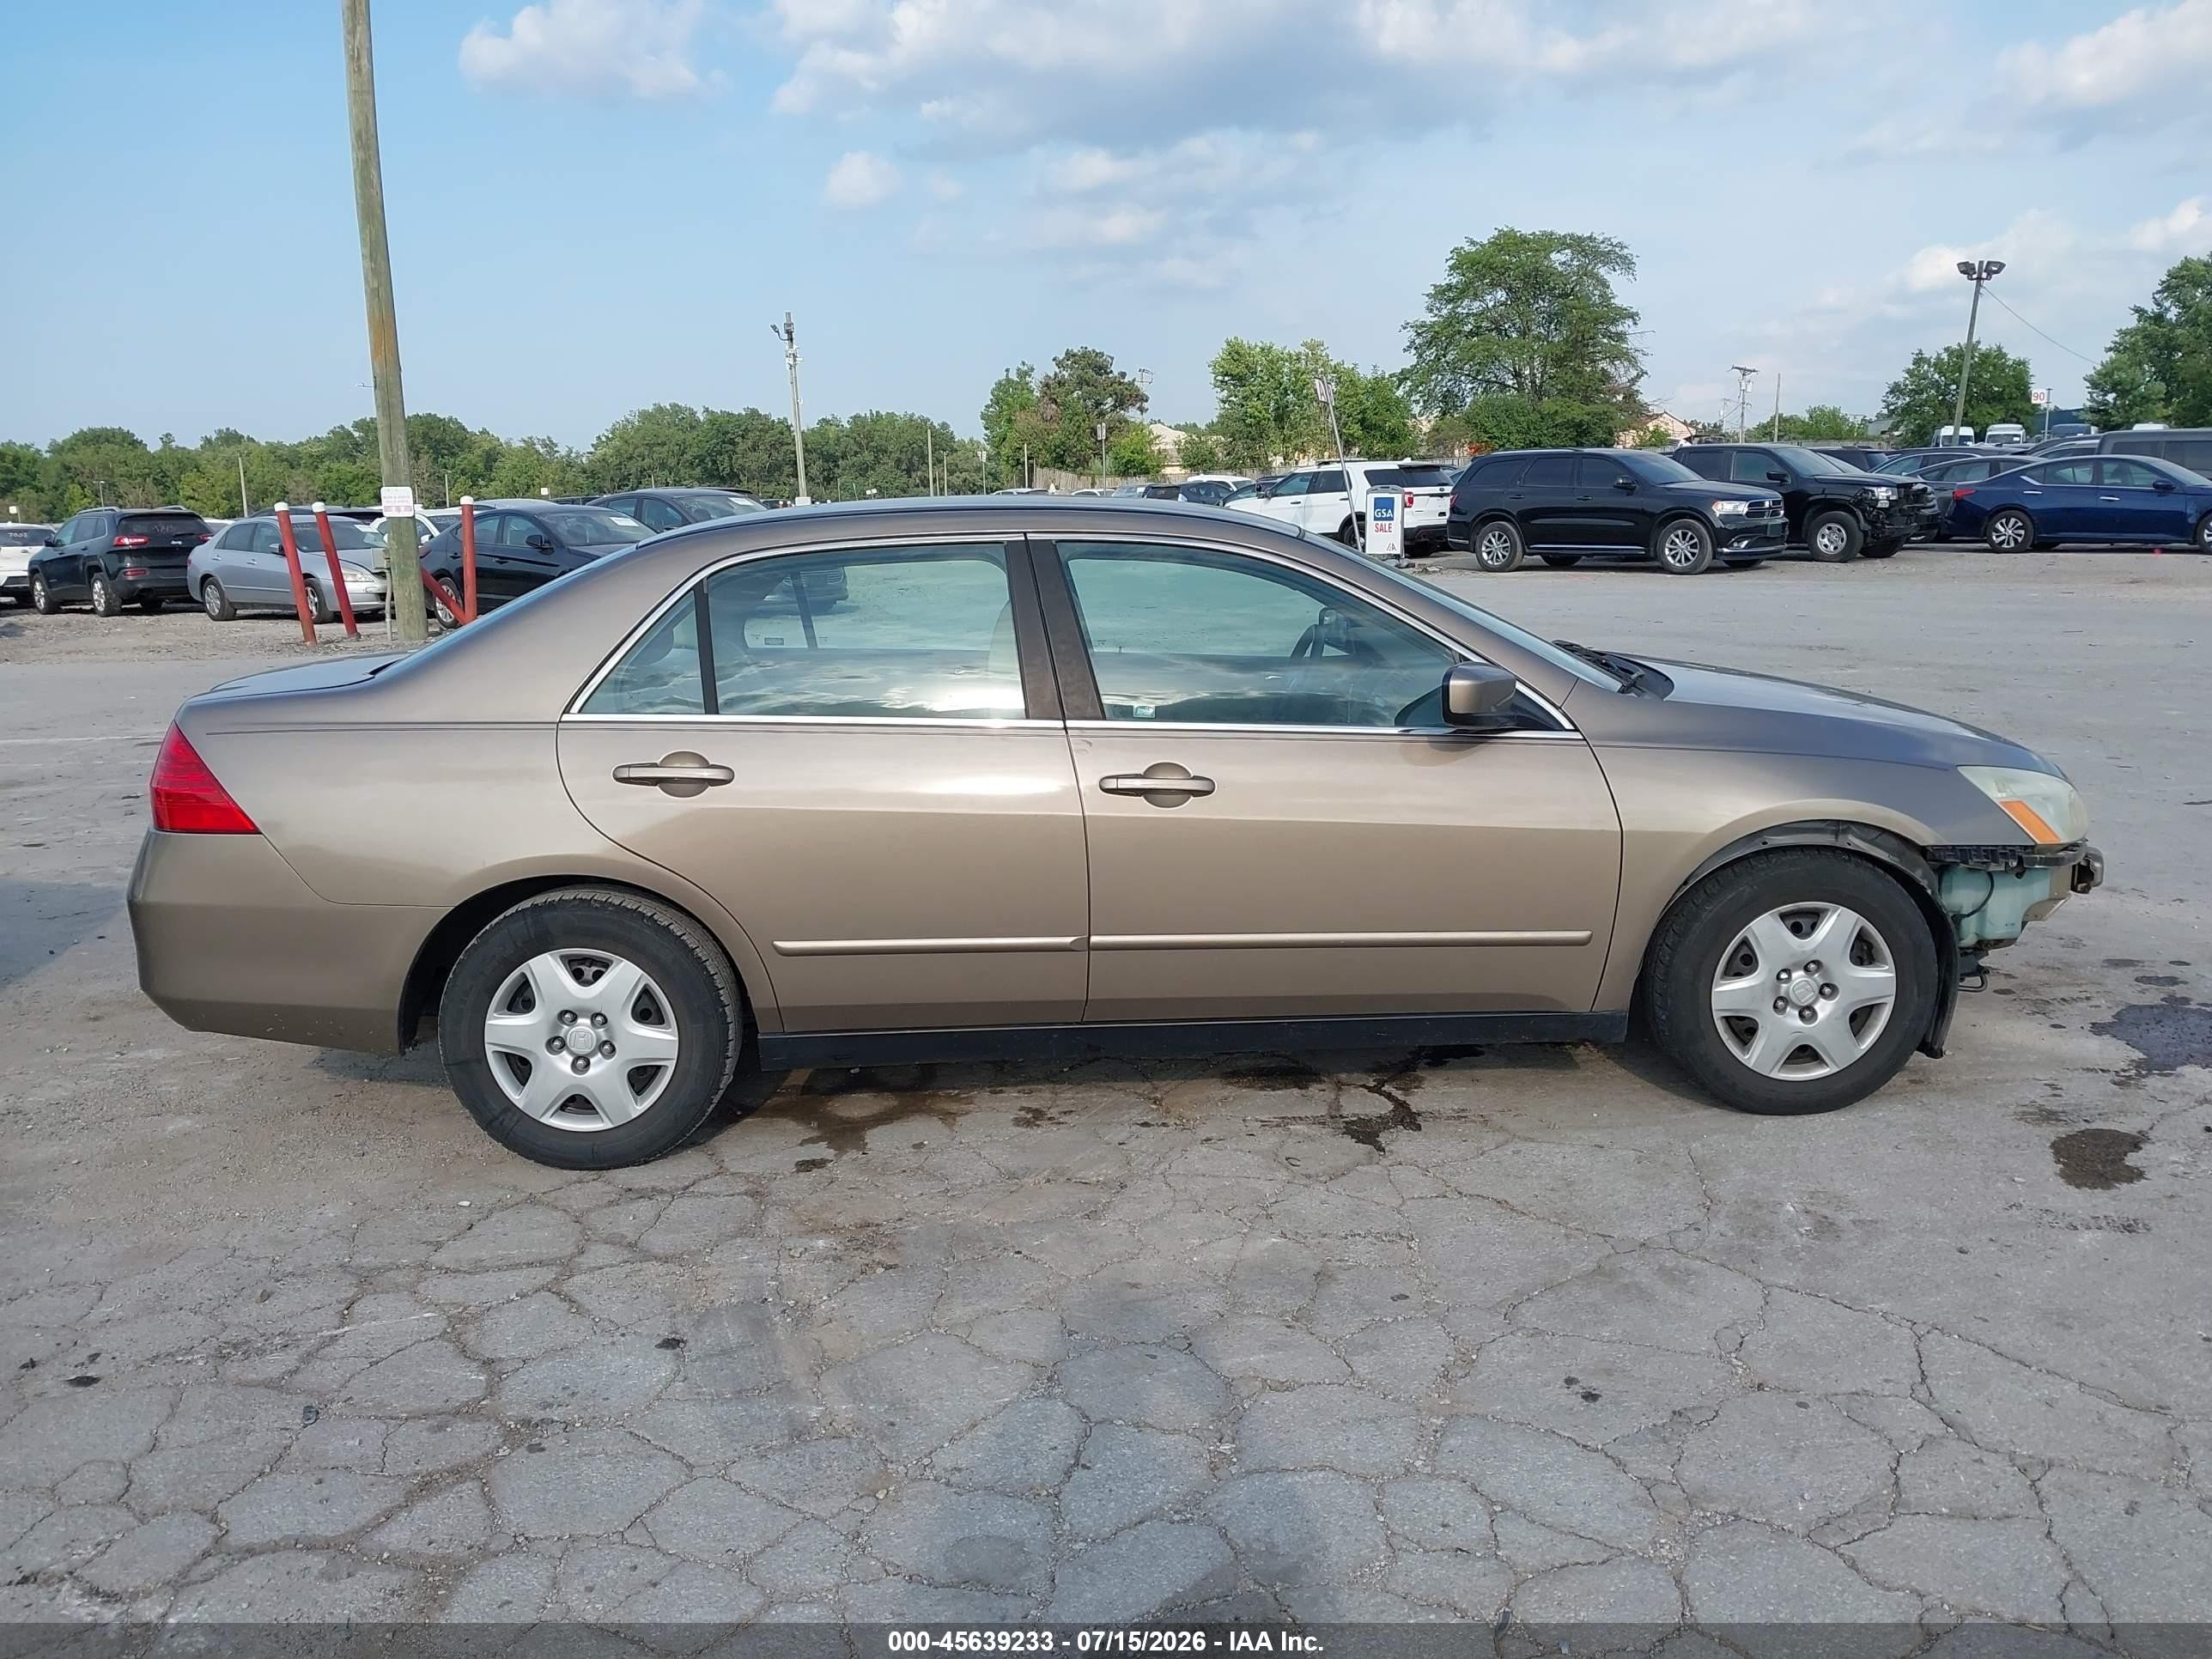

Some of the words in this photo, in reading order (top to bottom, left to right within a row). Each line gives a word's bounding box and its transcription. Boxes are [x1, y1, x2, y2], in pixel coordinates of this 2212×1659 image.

[2033, 392, 2045, 401] 90
[1374, 508, 1394, 518] GSA
[1374, 522, 1393, 533] SALE
